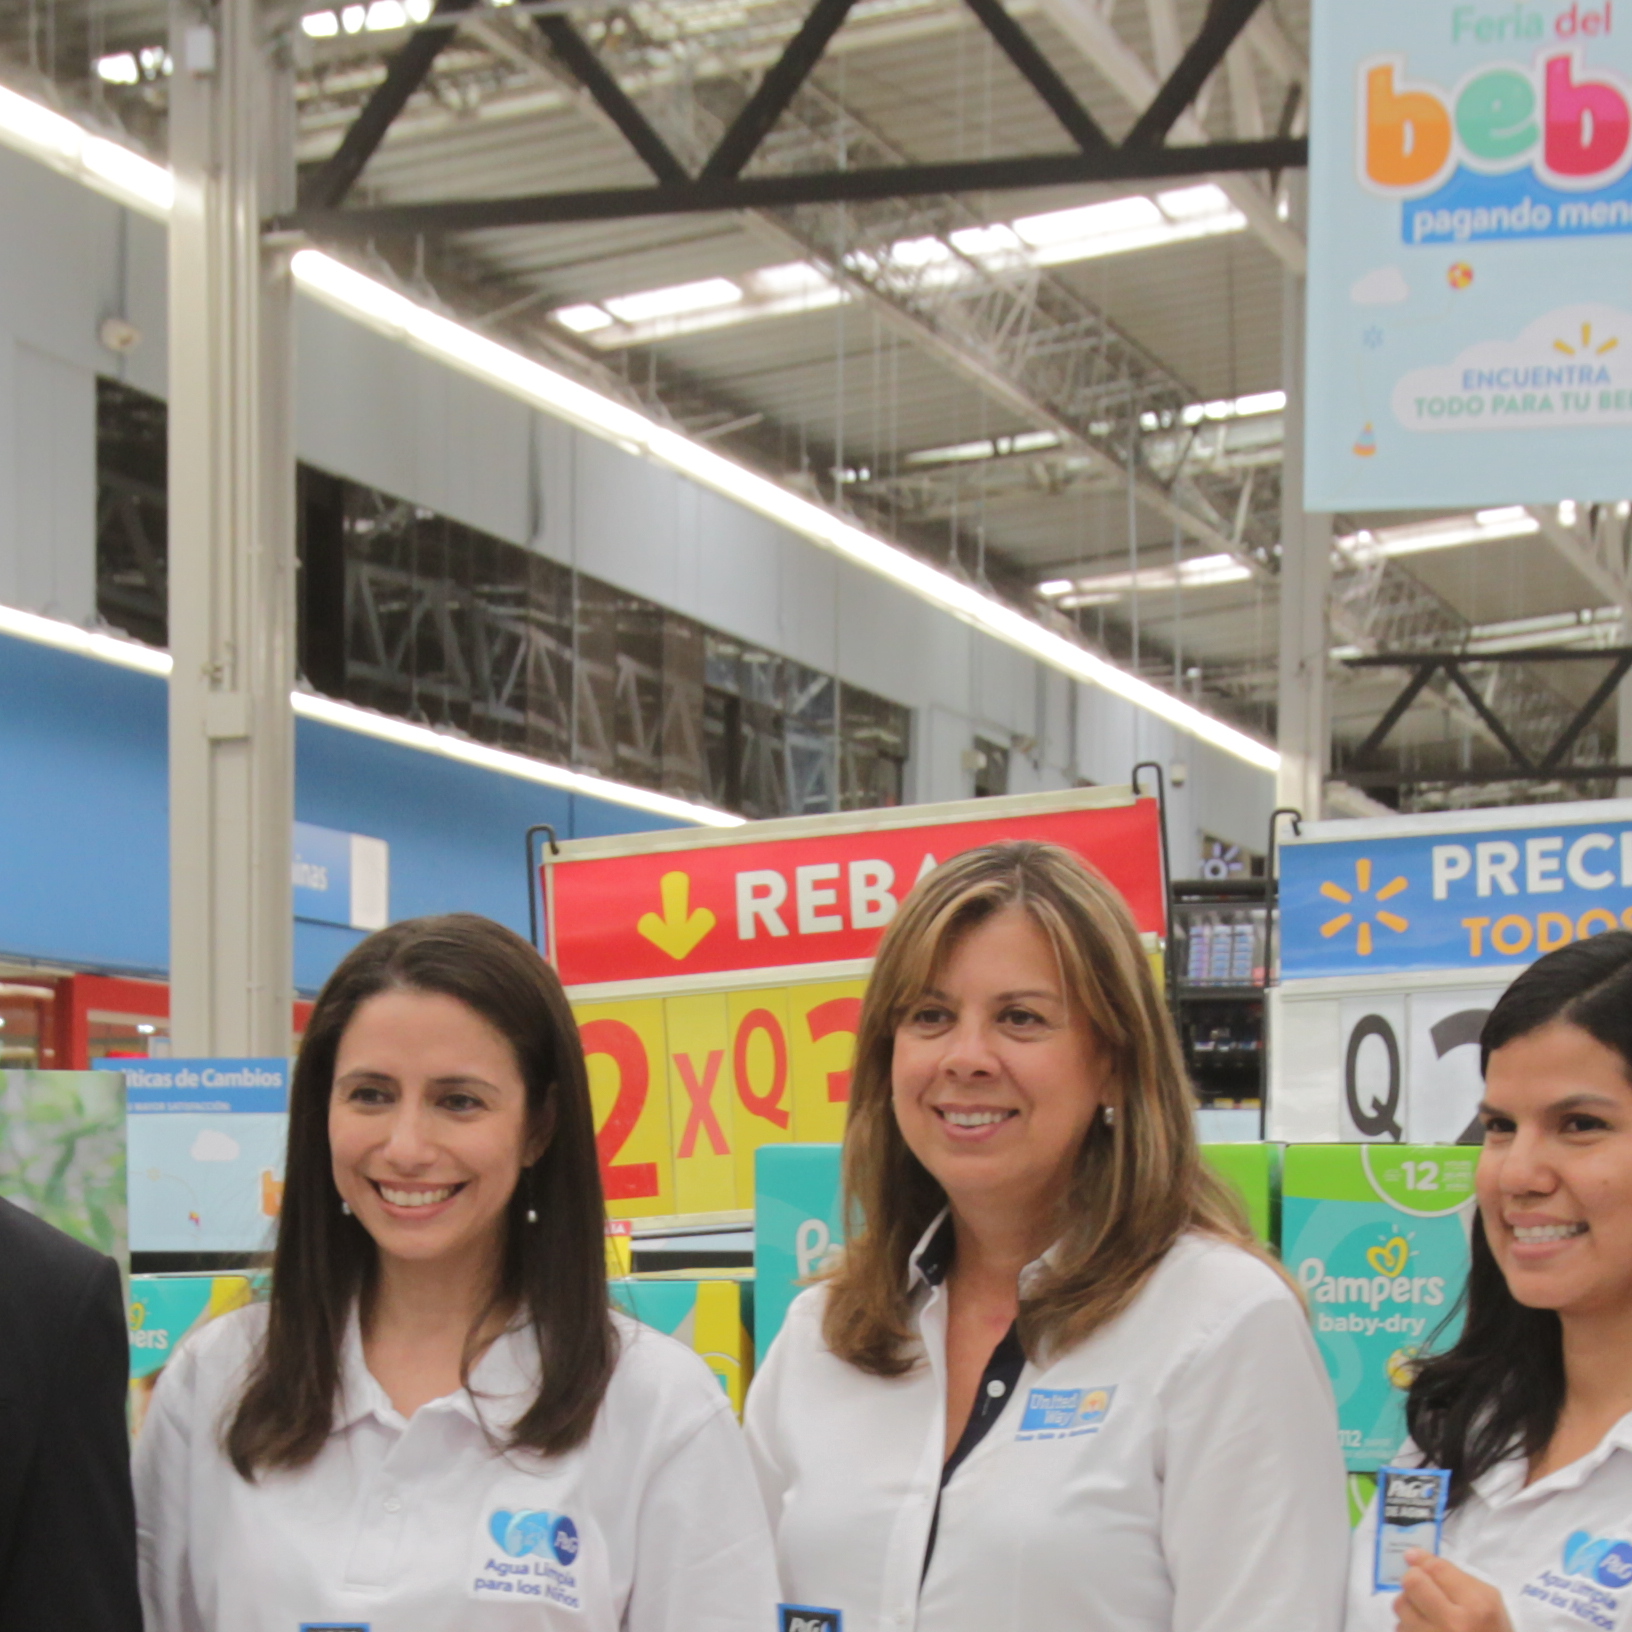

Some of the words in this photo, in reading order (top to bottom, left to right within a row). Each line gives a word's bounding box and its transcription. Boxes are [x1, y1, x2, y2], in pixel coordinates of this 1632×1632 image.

[1452, 6, 1544, 43] Feria
[1555, 0, 1613, 38] del
[1413, 198, 1551, 242] pagando
[1463, 365, 1611, 392] ENCUENTRA
[1415, 395, 1485, 419] TODO
[1491, 393, 1554, 415] PARA
[1561, 392, 1592, 412] TU
[735, 854, 936, 940] REB
[176, 1067, 198, 1088] de
[202, 1066, 283, 1088] Cambios
[1401, 1161, 1439, 1191] 12
[1298, 1257, 1446, 1311] Pampers
[1318, 1313, 1426, 1336] baby-dry
[473, 1577, 514, 1595] para
[517, 1582, 542, 1596] los
[484, 1558, 530, 1577] Agua
[534, 1561, 577, 1589] Limpia
[1537, 1569, 1572, 1594] Agua
[1520, 1583, 1549, 1603] para
[1570, 1597, 1616, 1631] Niños
